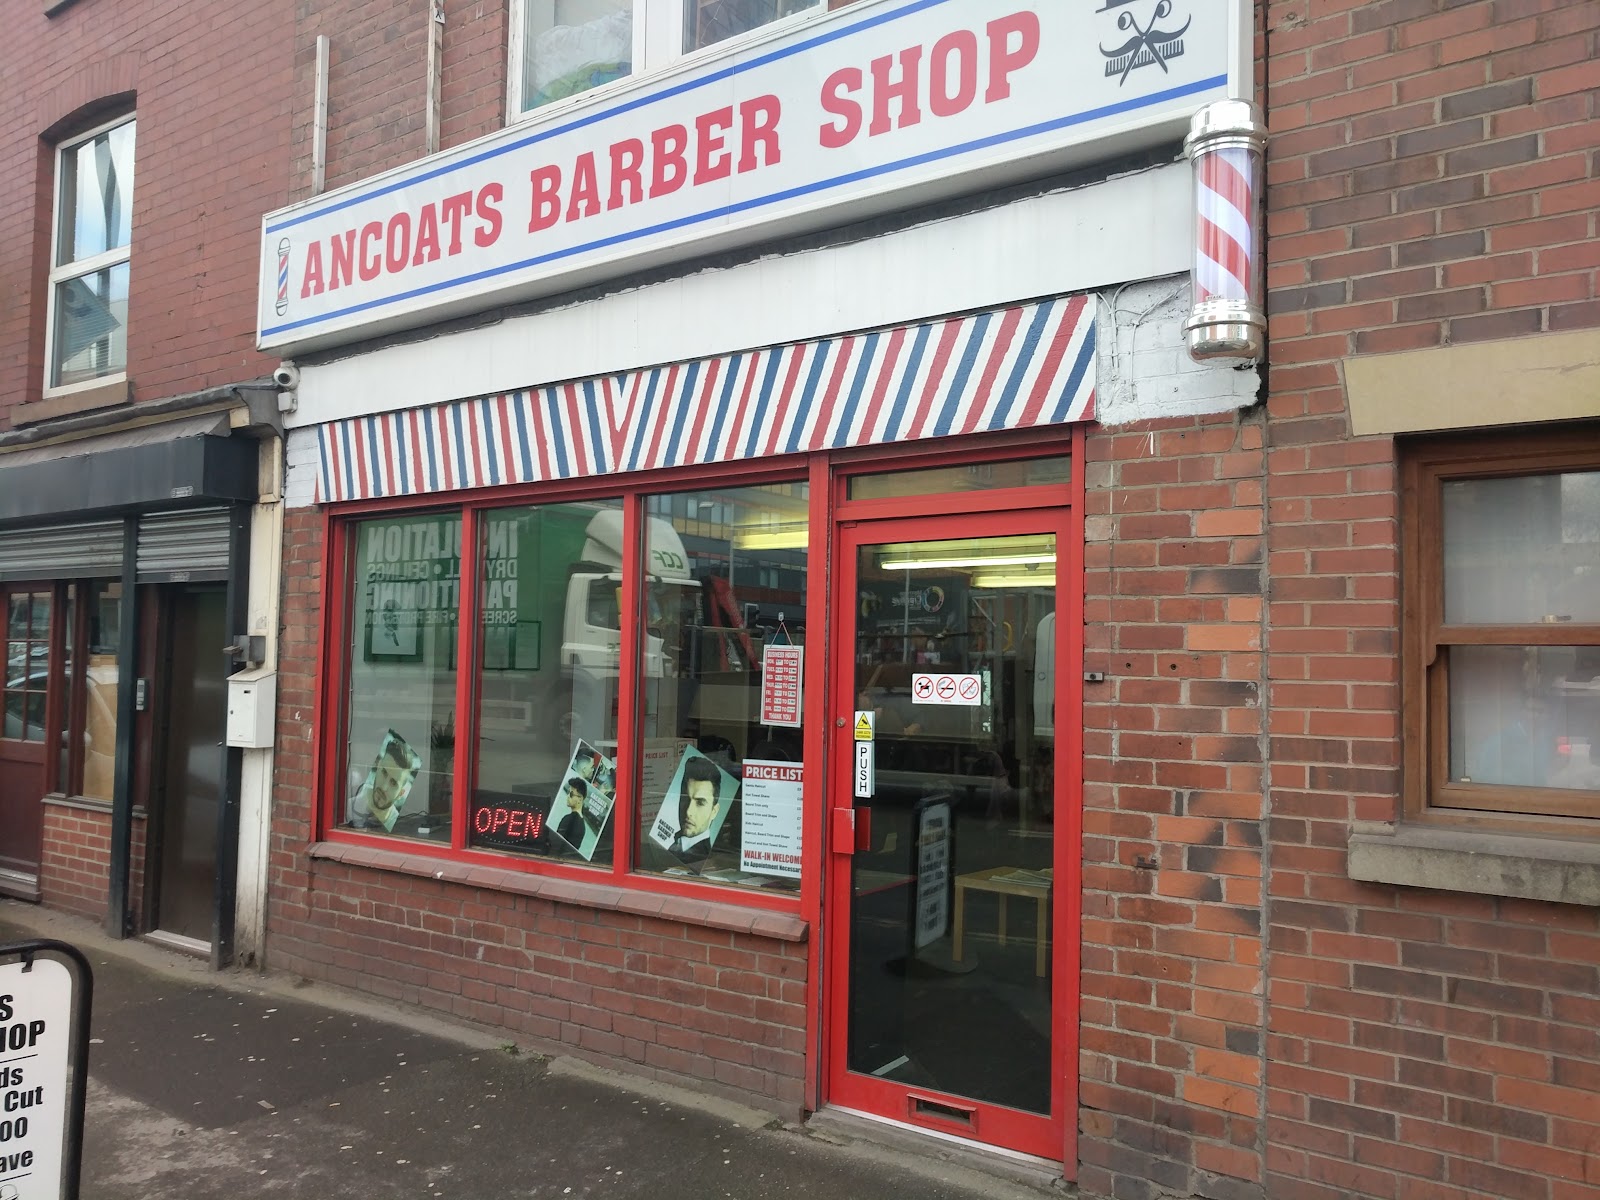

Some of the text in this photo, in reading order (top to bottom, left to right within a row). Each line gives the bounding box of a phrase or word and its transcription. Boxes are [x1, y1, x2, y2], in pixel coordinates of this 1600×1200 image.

[301, 11, 1041, 299] ANCOATS BARBER SHOP
[768, 712, 792, 721] THANK YOU
[745, 765, 803, 781] PRICE LIST
[859, 746, 868, 793] PUSH
[475, 807, 542, 840] OPEN
[743, 849, 772, 861] WALK-IN
[750, 860, 779, 870] Appointment
[779, 863, 803, 874] Necessar
[4, 1085, 44, 1113] Cut
